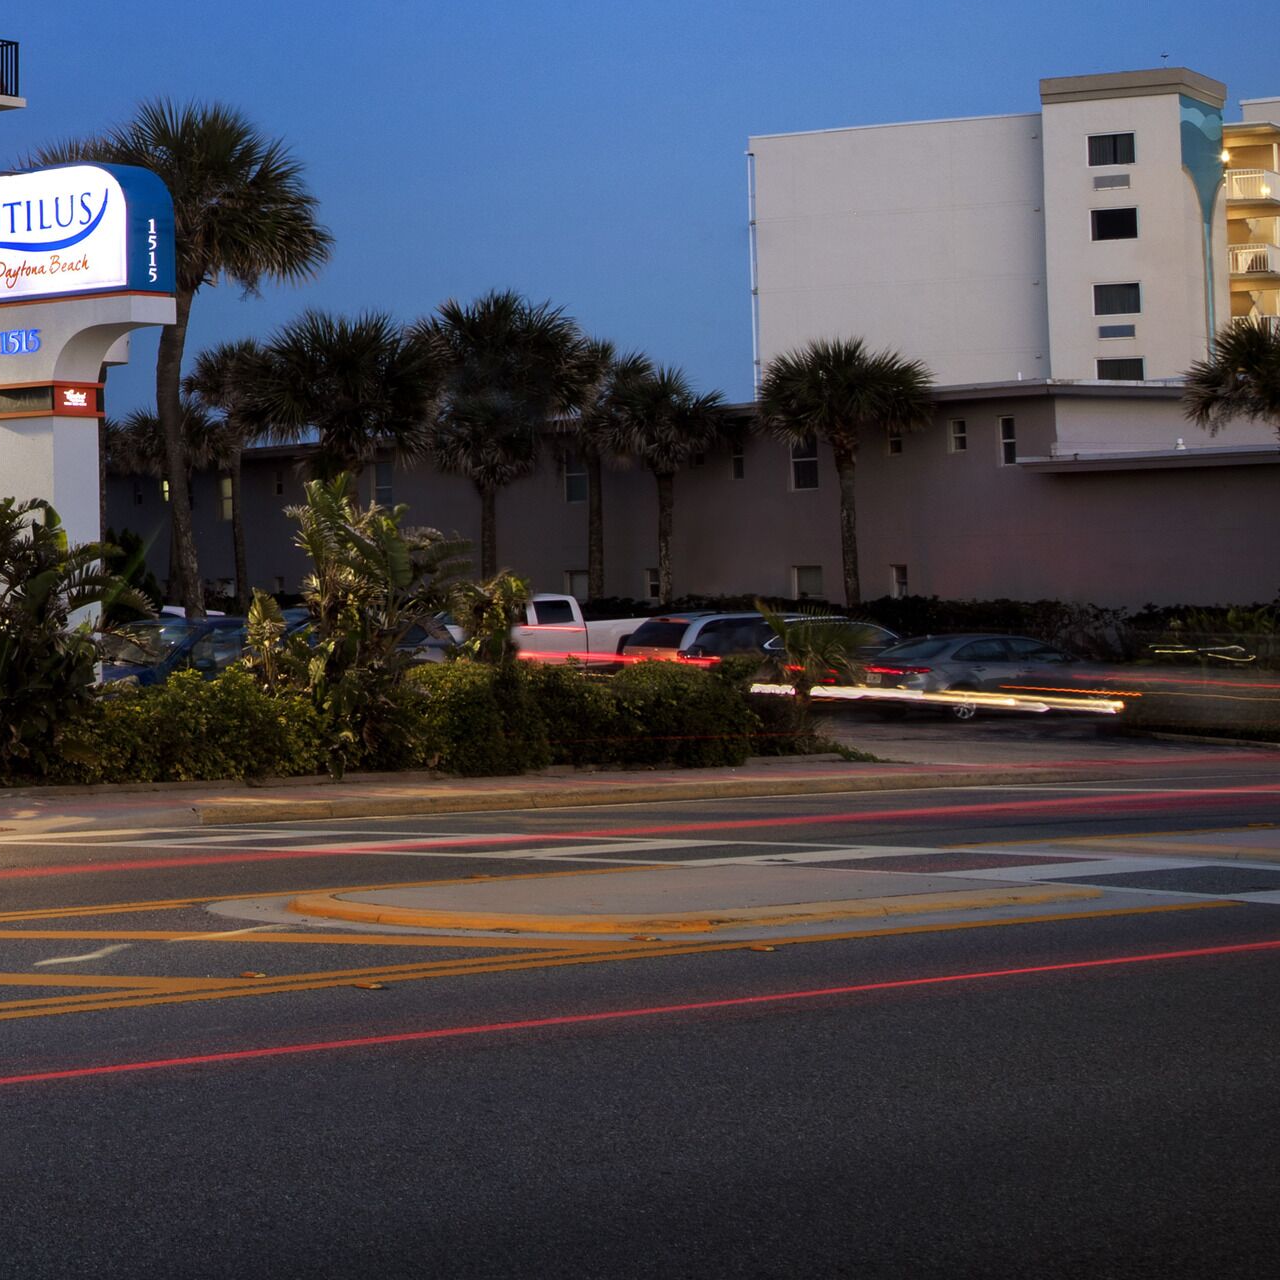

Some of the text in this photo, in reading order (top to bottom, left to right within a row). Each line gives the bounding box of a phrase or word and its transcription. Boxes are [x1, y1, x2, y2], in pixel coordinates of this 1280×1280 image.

[49, 253, 90, 275] Beach
[147, 218, 158, 283] 1515
[0, 328, 41, 355] 1515
